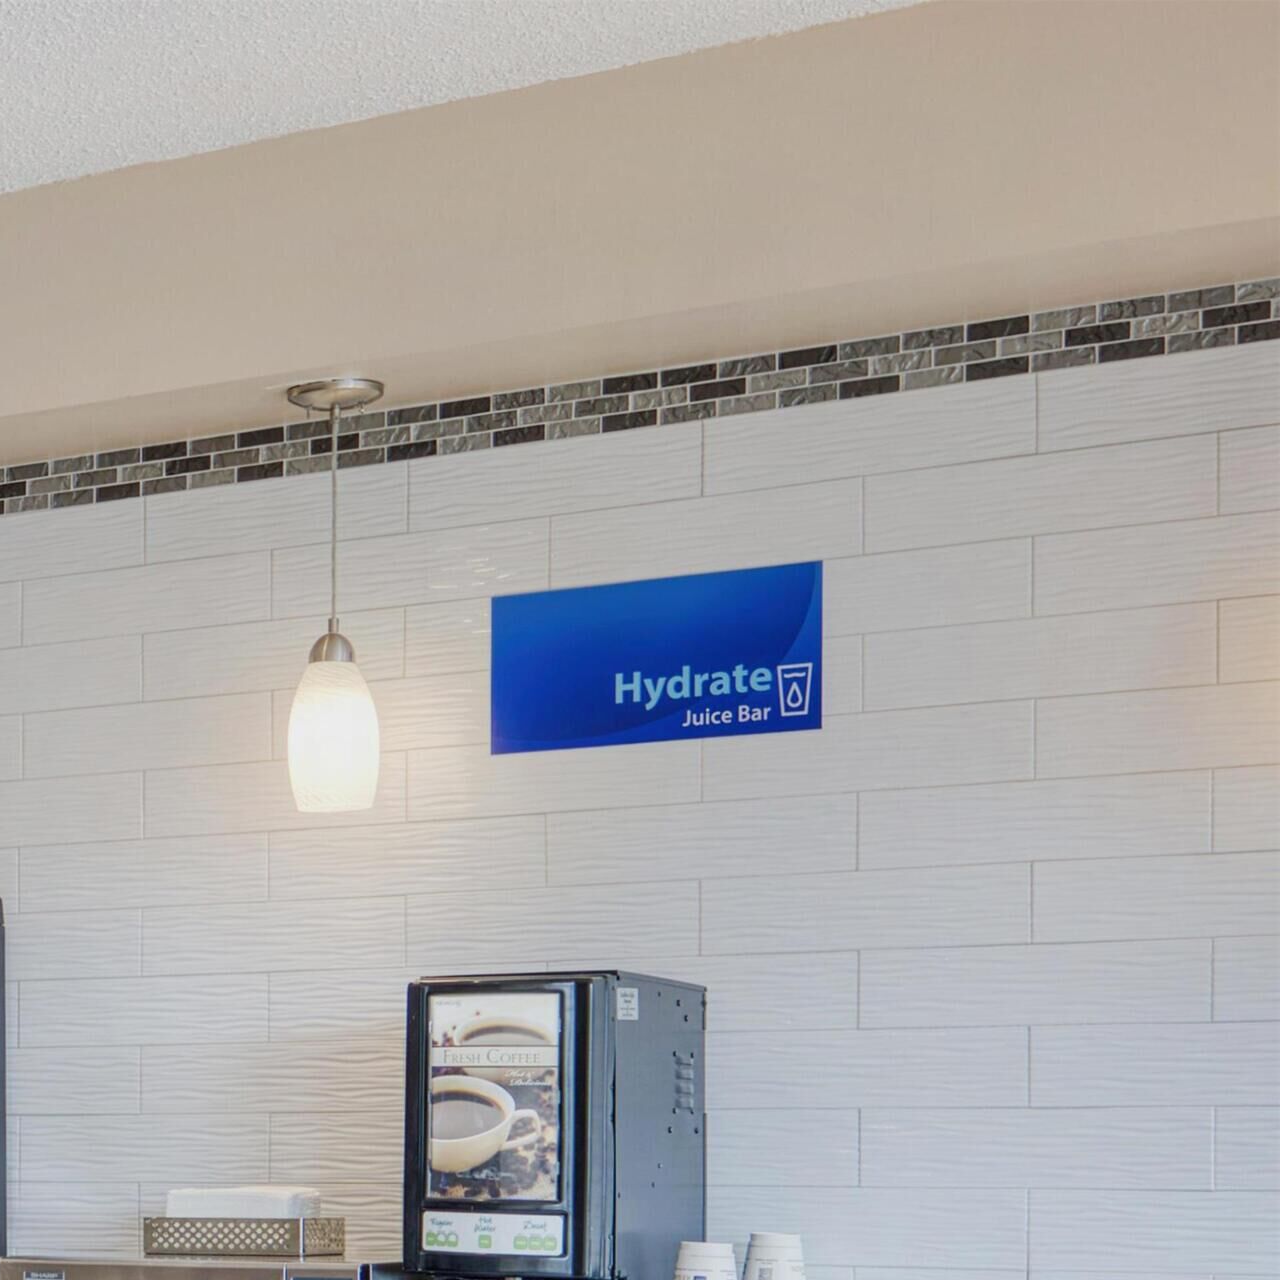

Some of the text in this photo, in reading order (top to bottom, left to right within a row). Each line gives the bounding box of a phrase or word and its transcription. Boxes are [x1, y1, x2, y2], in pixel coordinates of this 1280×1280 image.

[614, 663, 773, 711] Hydrate
[681, 705, 771, 728] Juice Bar
